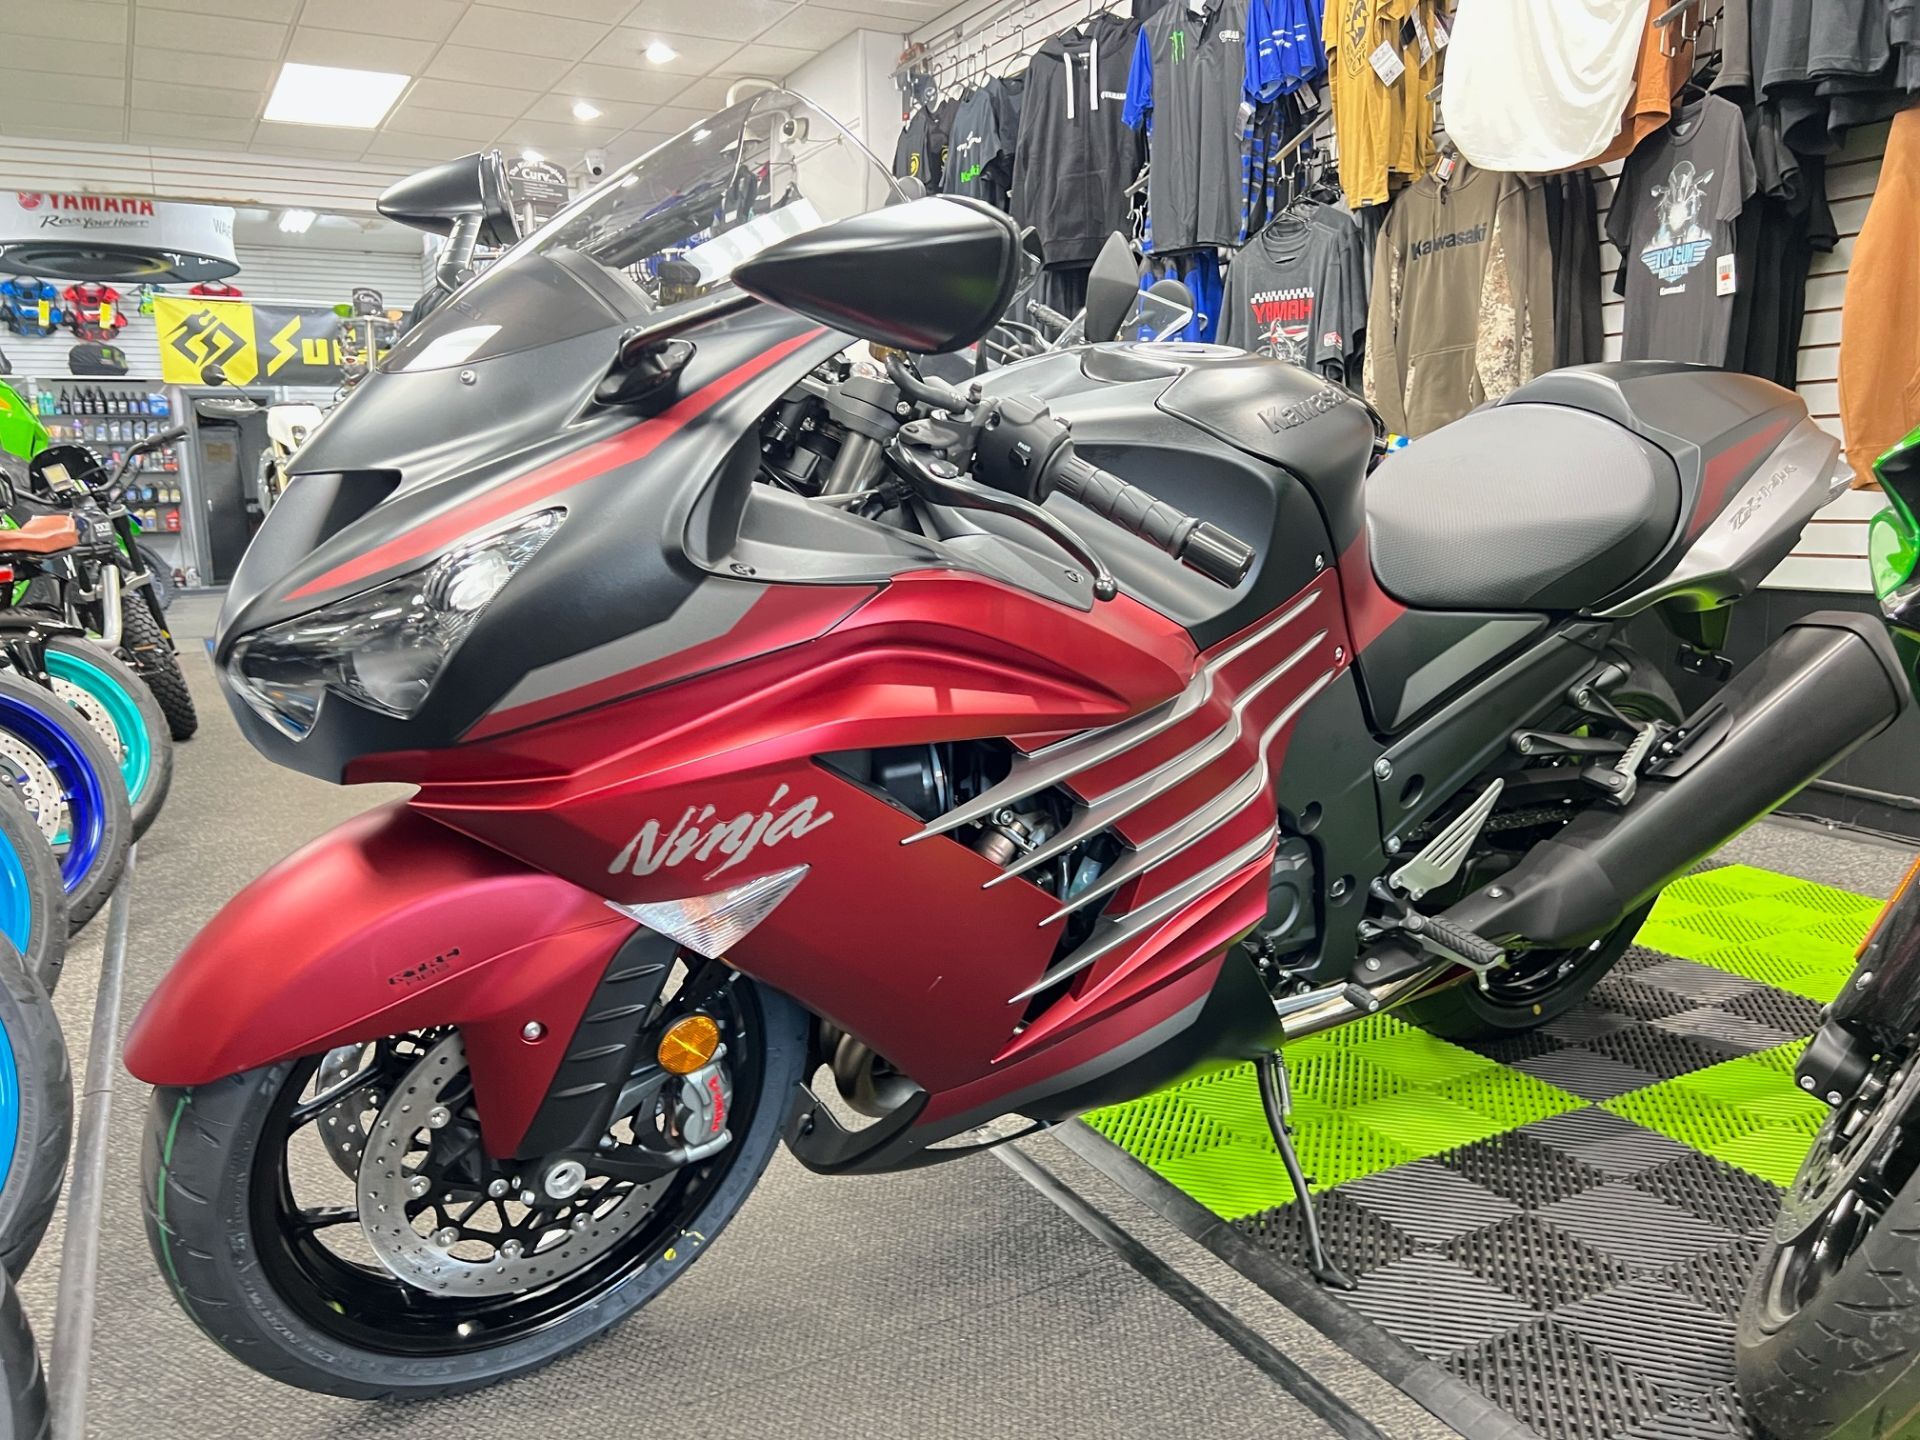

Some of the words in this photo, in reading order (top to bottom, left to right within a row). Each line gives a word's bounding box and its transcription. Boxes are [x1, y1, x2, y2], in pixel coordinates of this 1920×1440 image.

[50, 192, 154, 216] YAMAHA
[1411, 222, 1488, 261] Kawasaki
[608, 783, 834, 881] Ninja
